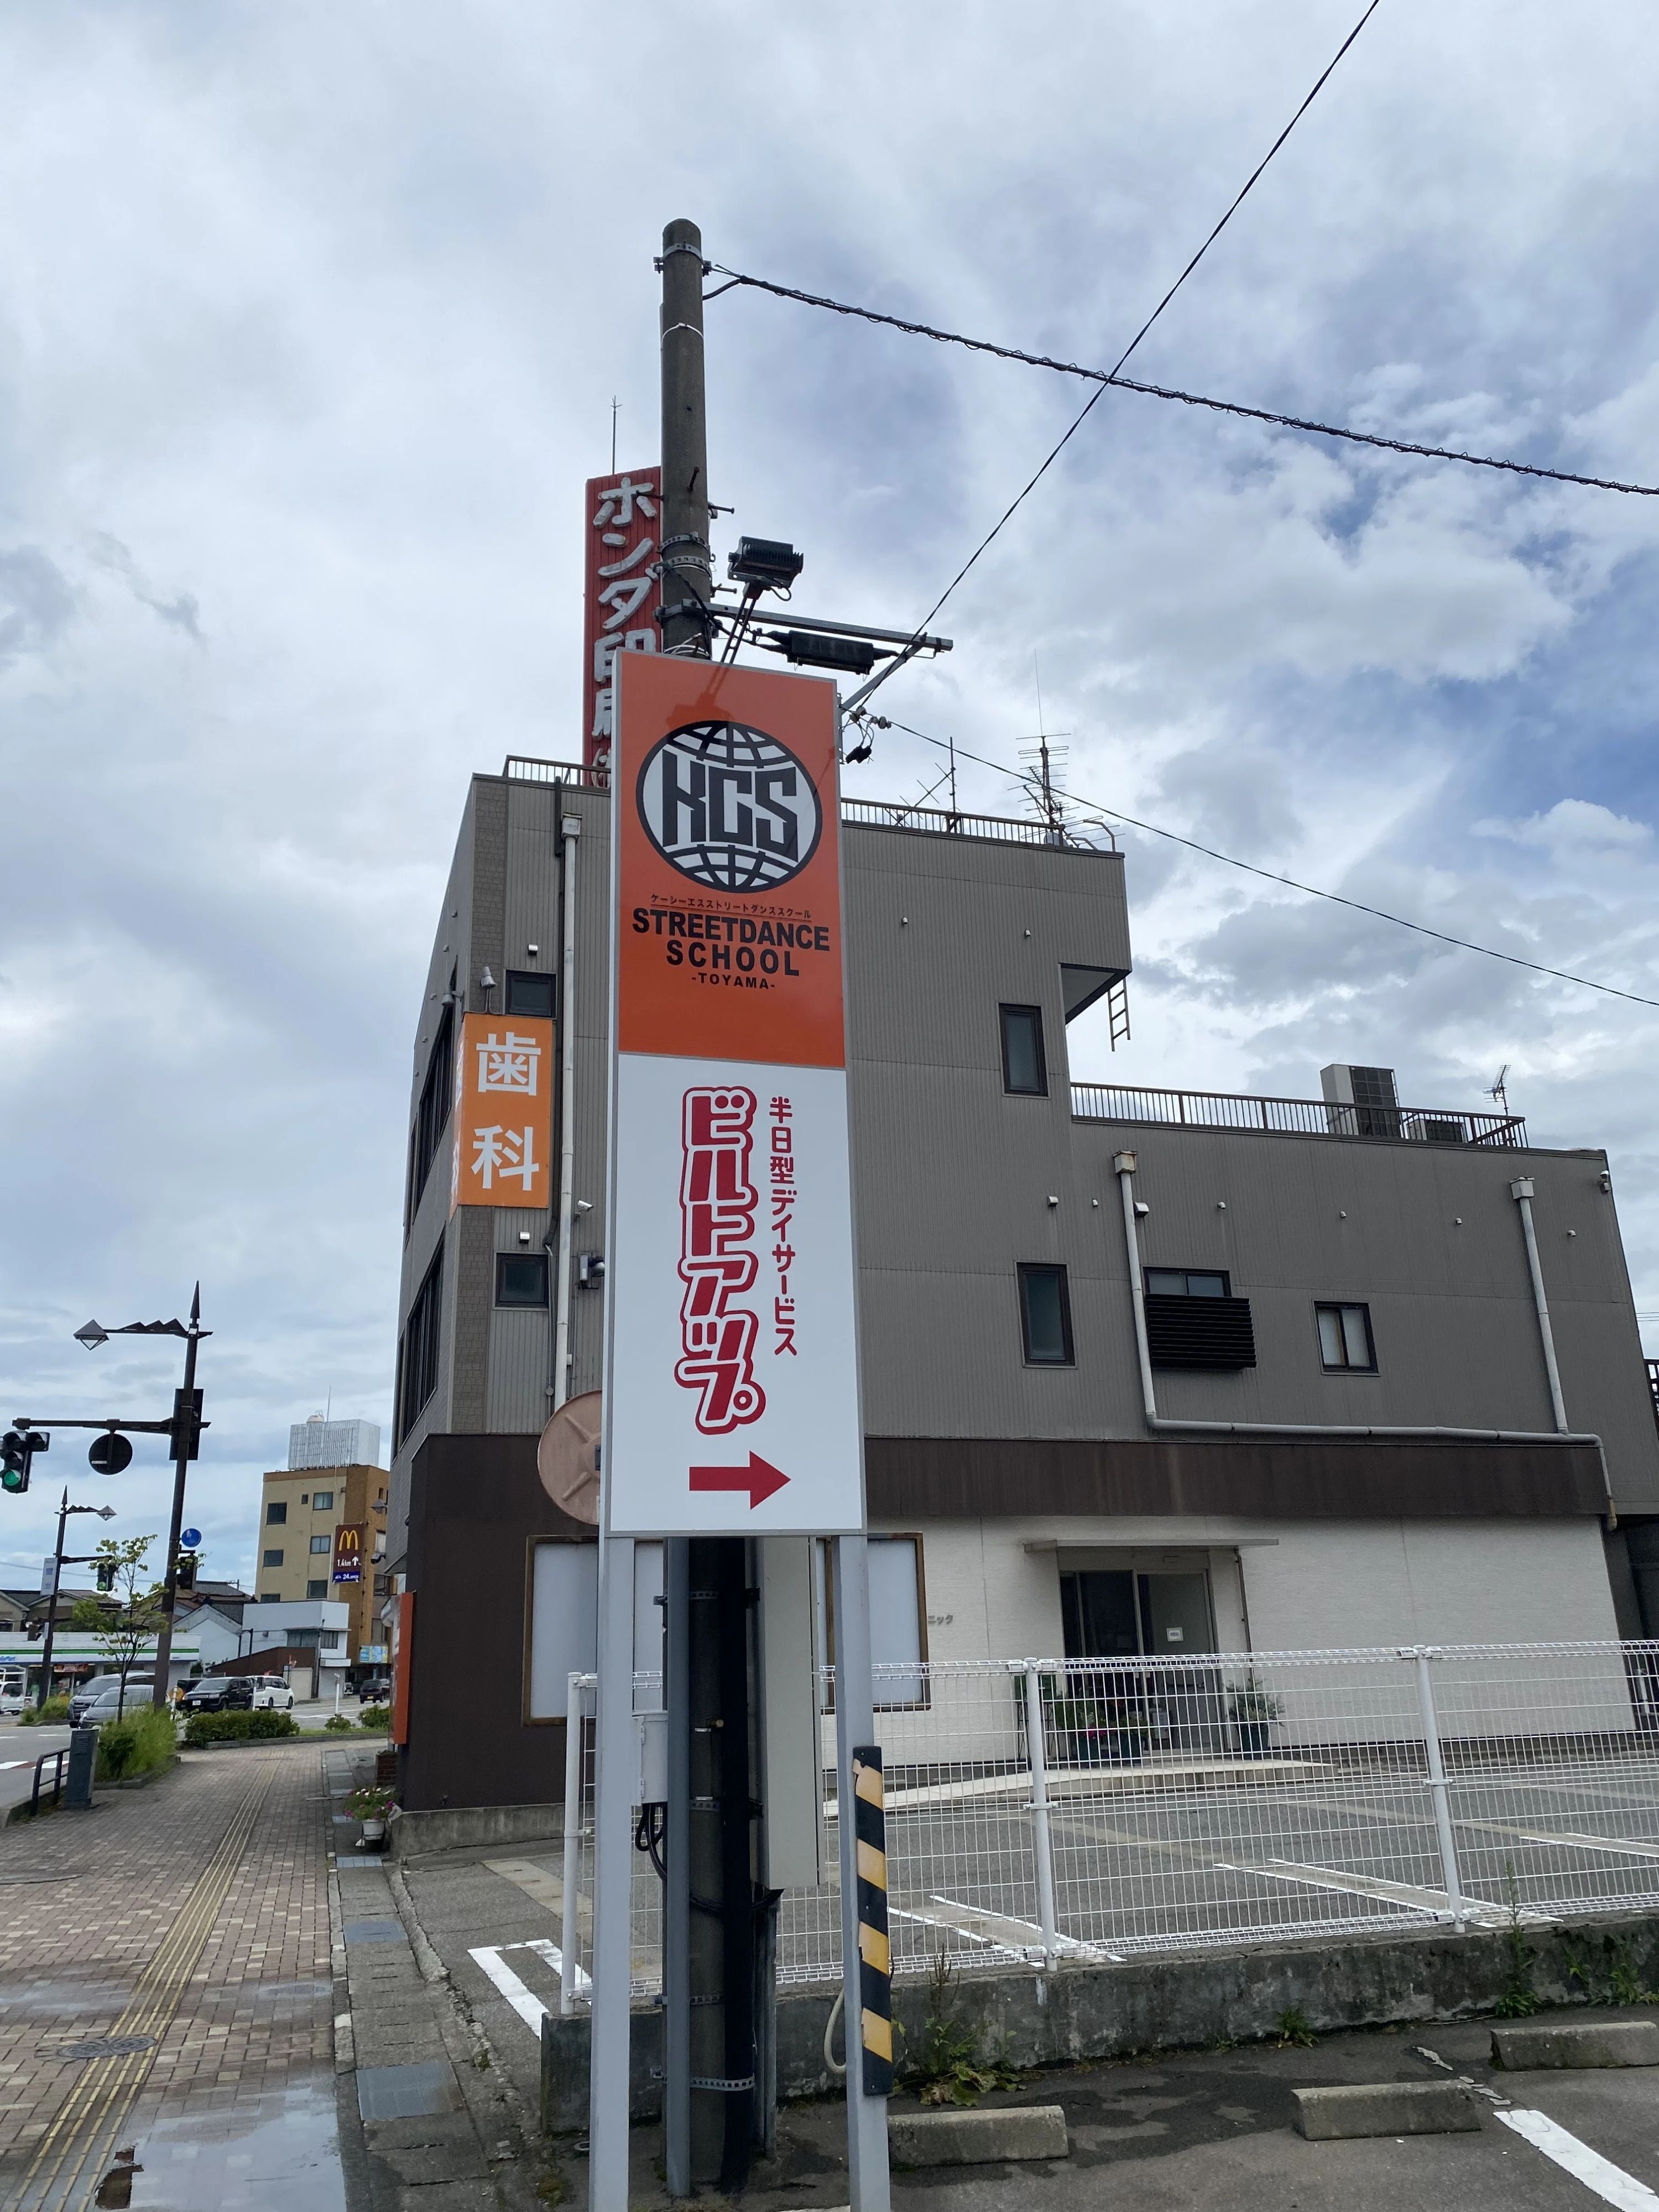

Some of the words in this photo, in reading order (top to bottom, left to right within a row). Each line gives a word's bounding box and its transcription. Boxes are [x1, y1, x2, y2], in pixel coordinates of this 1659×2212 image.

[662, 748, 799, 863] KCS
[632, 907, 830, 952] STREETDANCE
[650, 893, 811, 919] ケーシーエスストリートダンススクール
[666, 940, 800, 977] SCHOOL
[471, 1031, 541, 1191] 歯科
[675, 1087, 766, 1434] ビルトアップ
[769, 1096, 797, 1356] 半日型デイサービス
[337, 1558, 351, 1567] 1.4km
